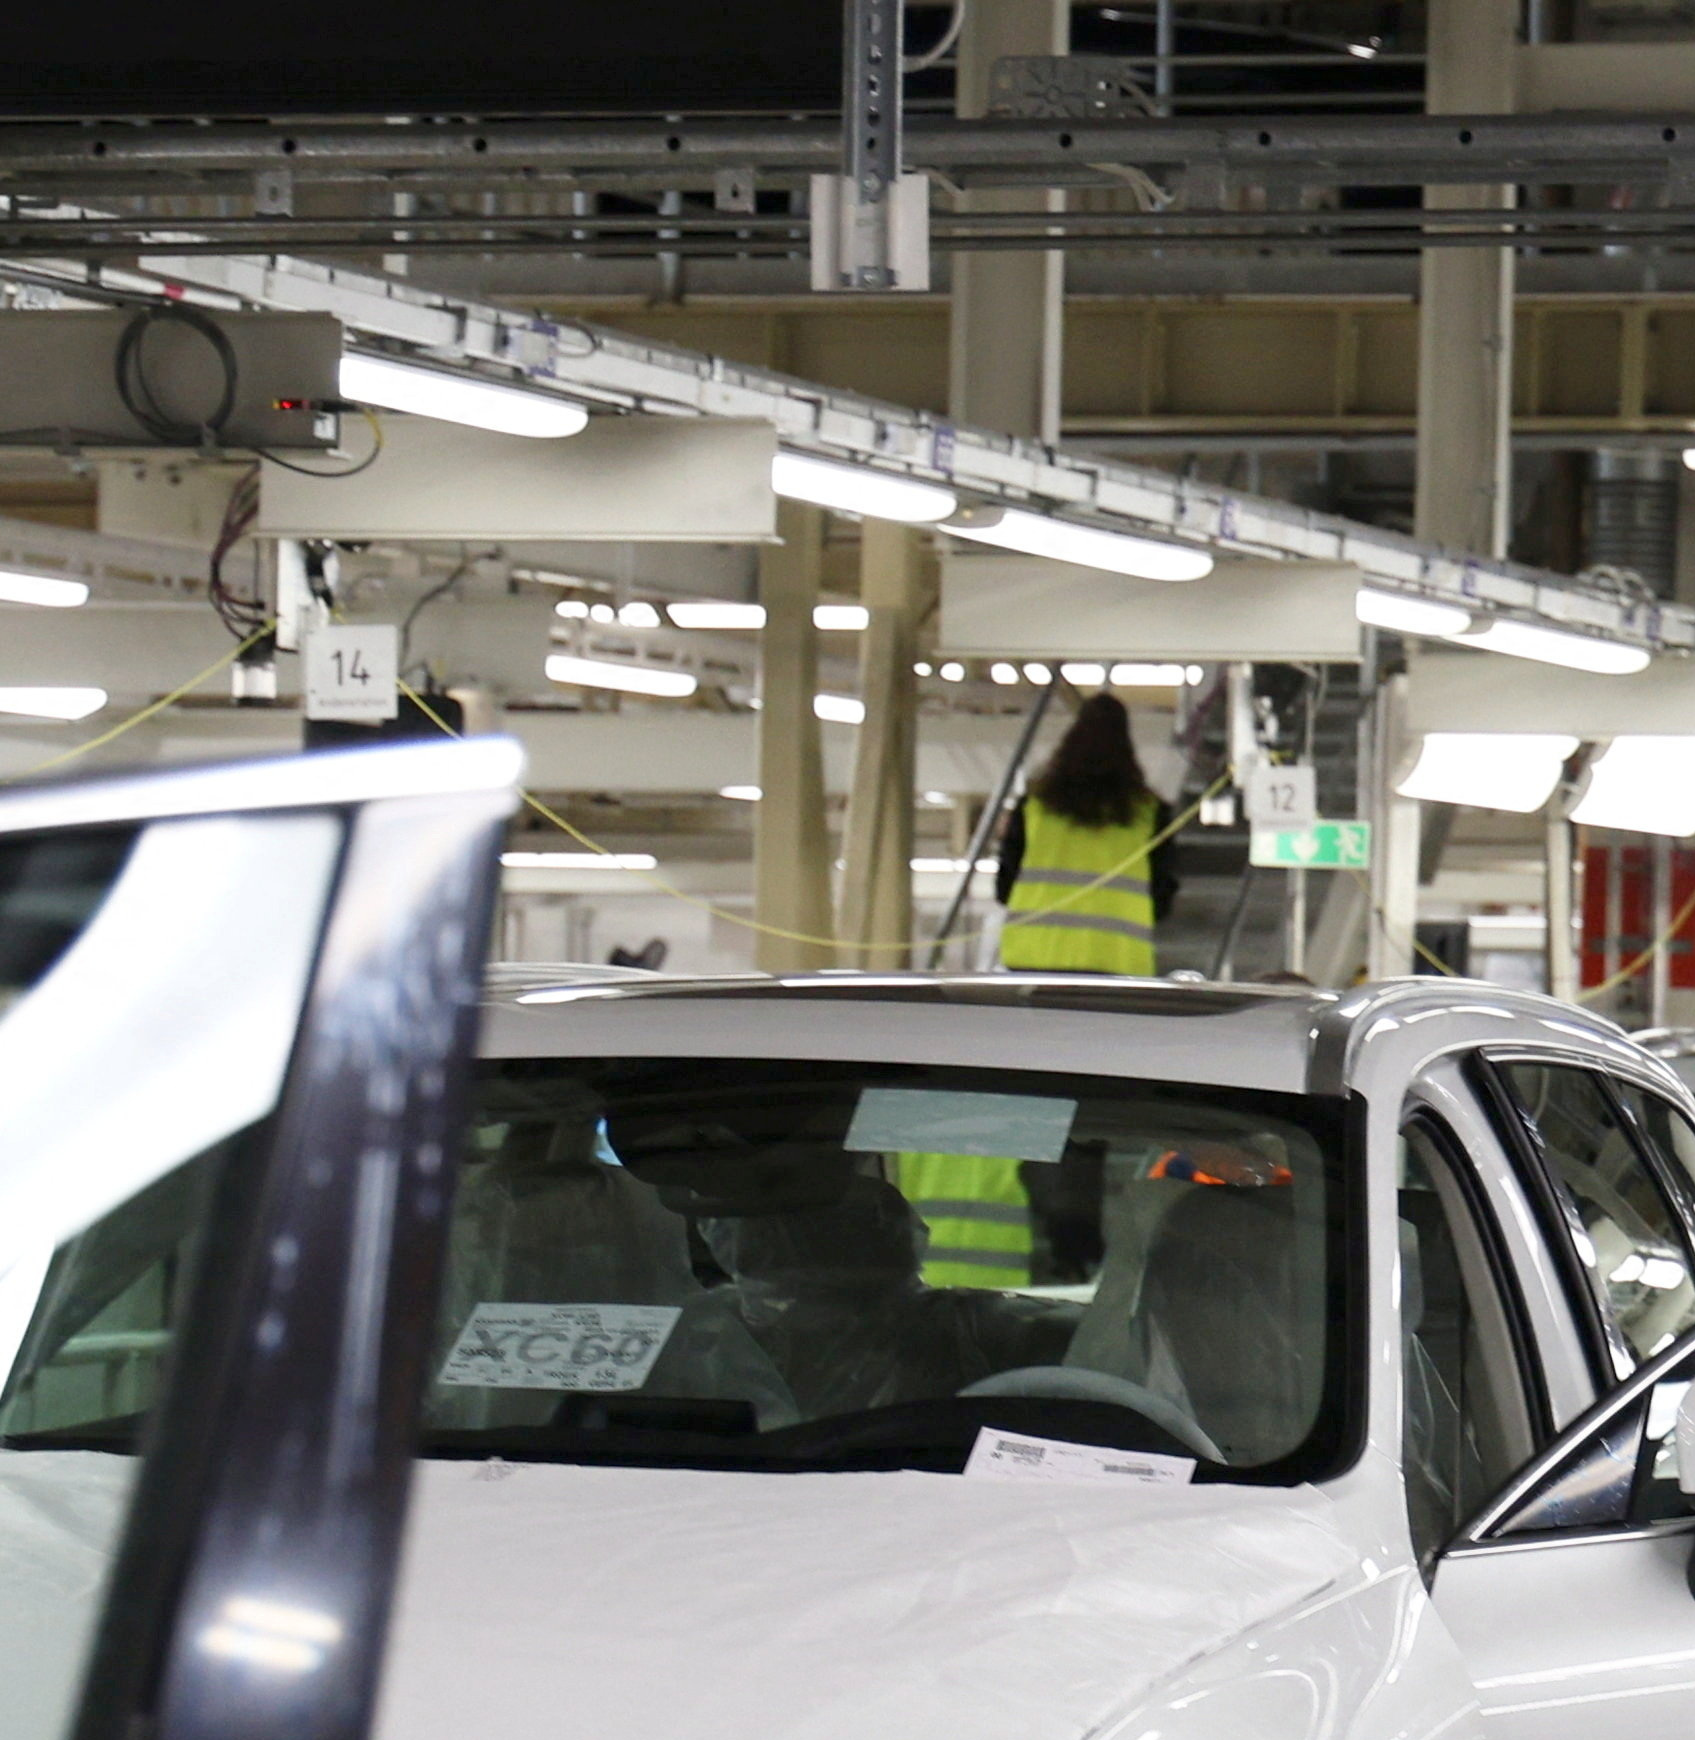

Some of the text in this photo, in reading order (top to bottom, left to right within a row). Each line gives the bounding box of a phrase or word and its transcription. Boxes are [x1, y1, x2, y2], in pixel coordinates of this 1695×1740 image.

[330, 649, 371, 687] 14
[1269, 782, 1296, 812] 12
[461, 1327, 656, 1367] XC60
